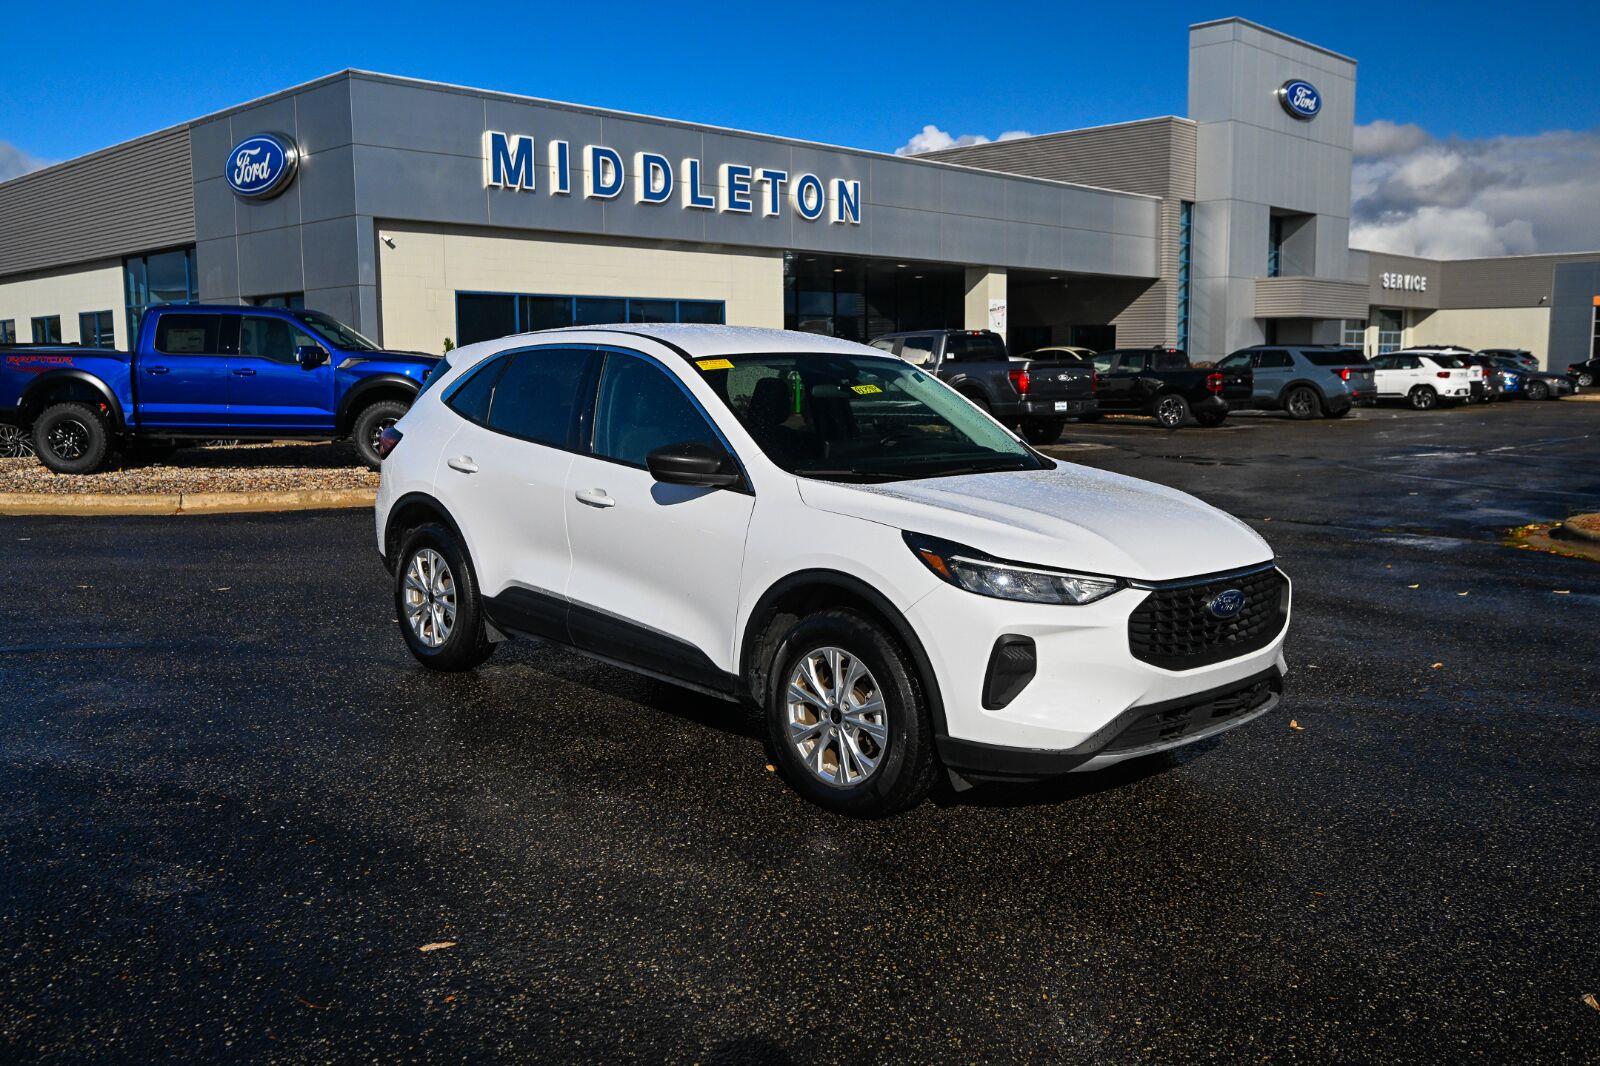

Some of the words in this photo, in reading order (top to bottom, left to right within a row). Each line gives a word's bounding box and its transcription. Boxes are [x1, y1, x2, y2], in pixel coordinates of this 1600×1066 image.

[1294, 87, 1317, 111] Ford
[235, 147, 271, 185] Ford
[483, 130, 861, 225] MIDDLETON
[1382, 272, 1427, 290] SERVICE
[7, 356, 74, 367] RAPTOR
